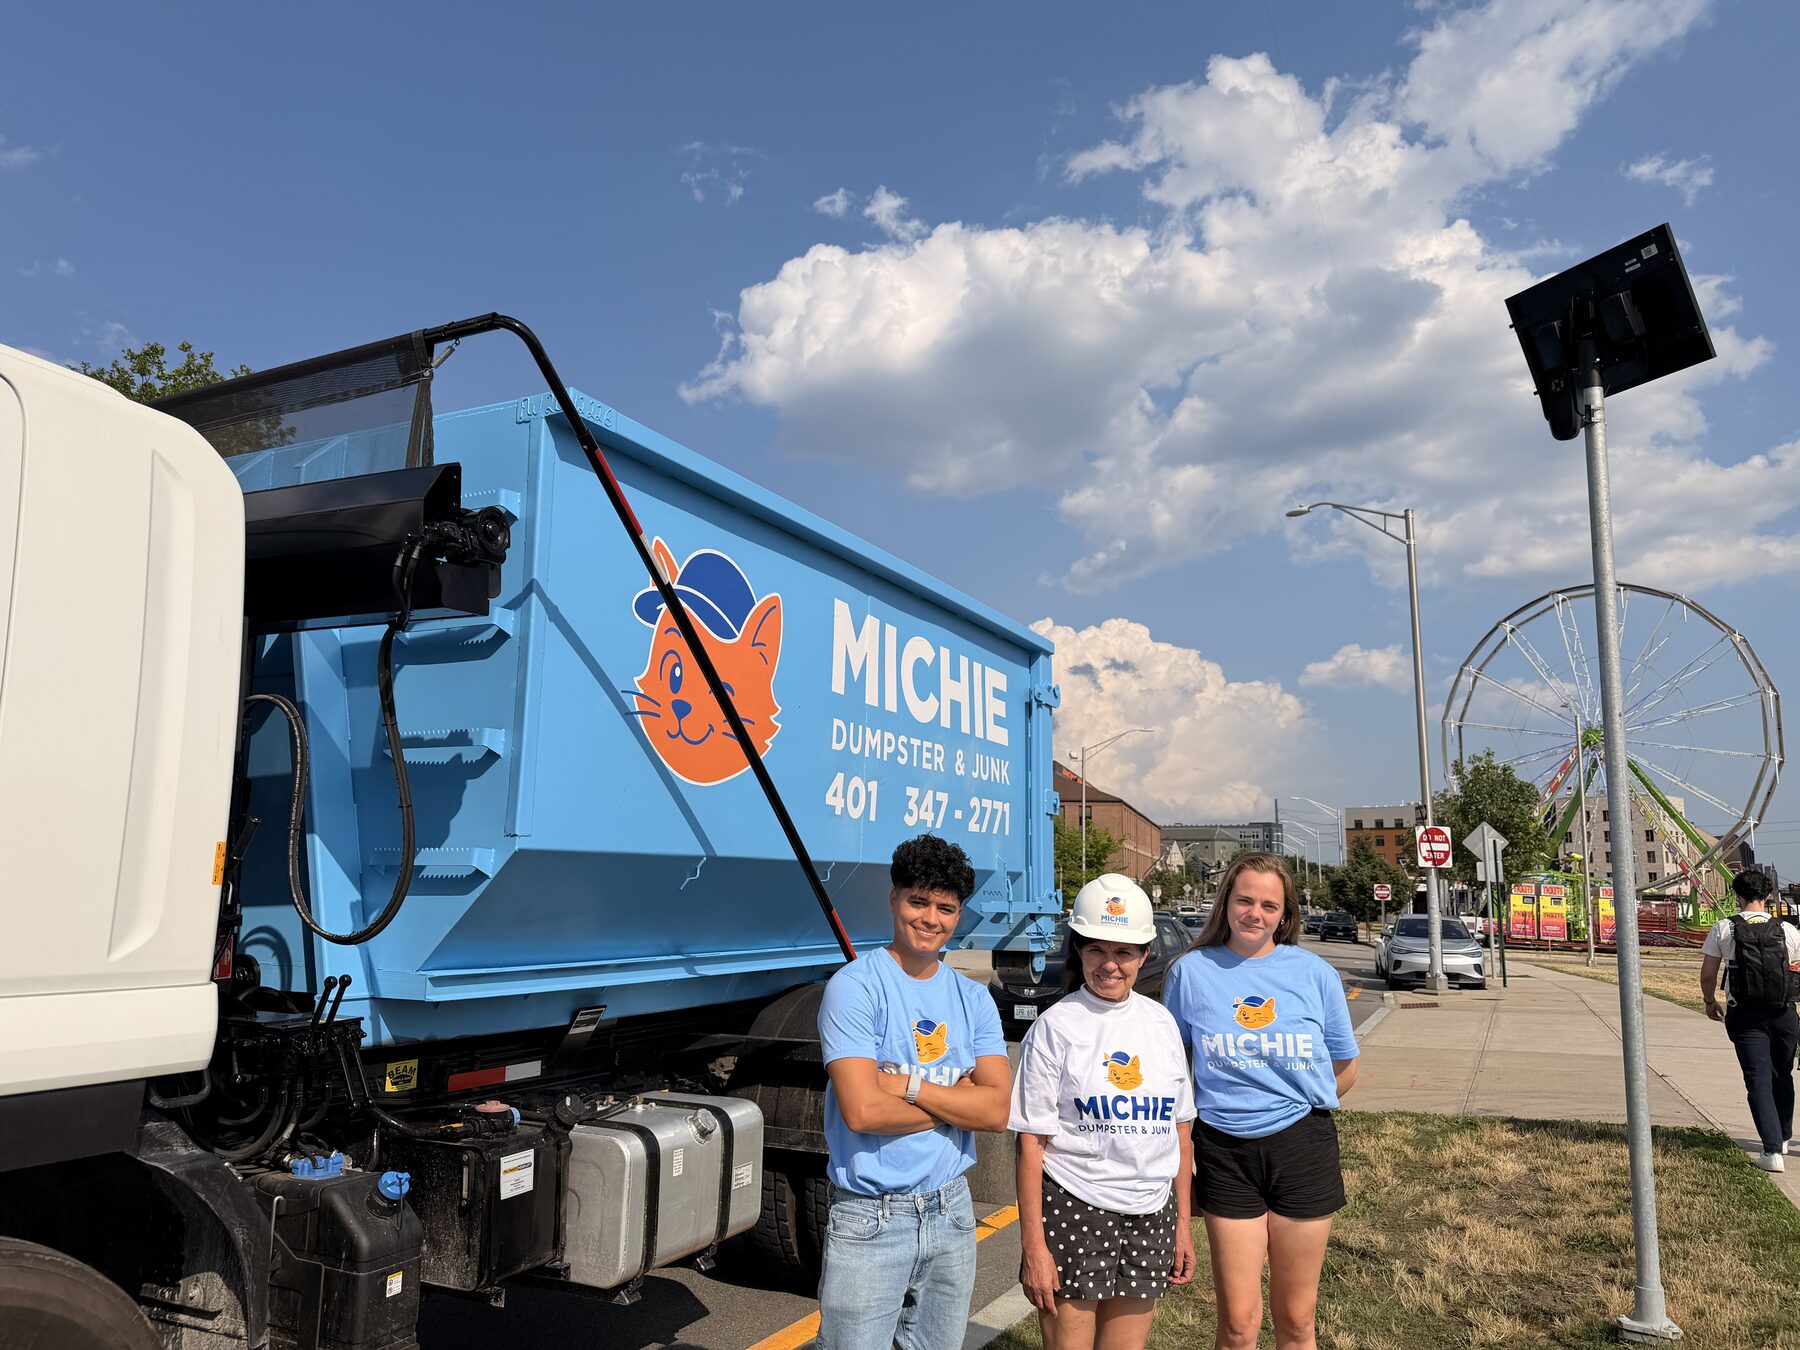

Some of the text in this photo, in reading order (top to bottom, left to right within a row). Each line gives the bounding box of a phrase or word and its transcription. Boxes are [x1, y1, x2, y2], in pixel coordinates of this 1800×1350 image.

[832, 598, 1008, 746] MICHIE
[832, 718, 1010, 785] DUMPSTER & JUNK
[825, 772, 878, 821] 401
[904, 786, 949, 829] 347
[968, 797, 1010, 835] 2771
[1543, 886, 1563, 895] TICKETS
[1101, 915, 1128, 923] MICHIE
[1201, 1033, 1313, 1058] MICHIE
[388, 1065, 416, 1078] BEAM
[1074, 1095, 1175, 1121] MICHIE
[1079, 1124, 1137, 1135] DUMPSTER
[1141, 1126, 1148, 1134] &
